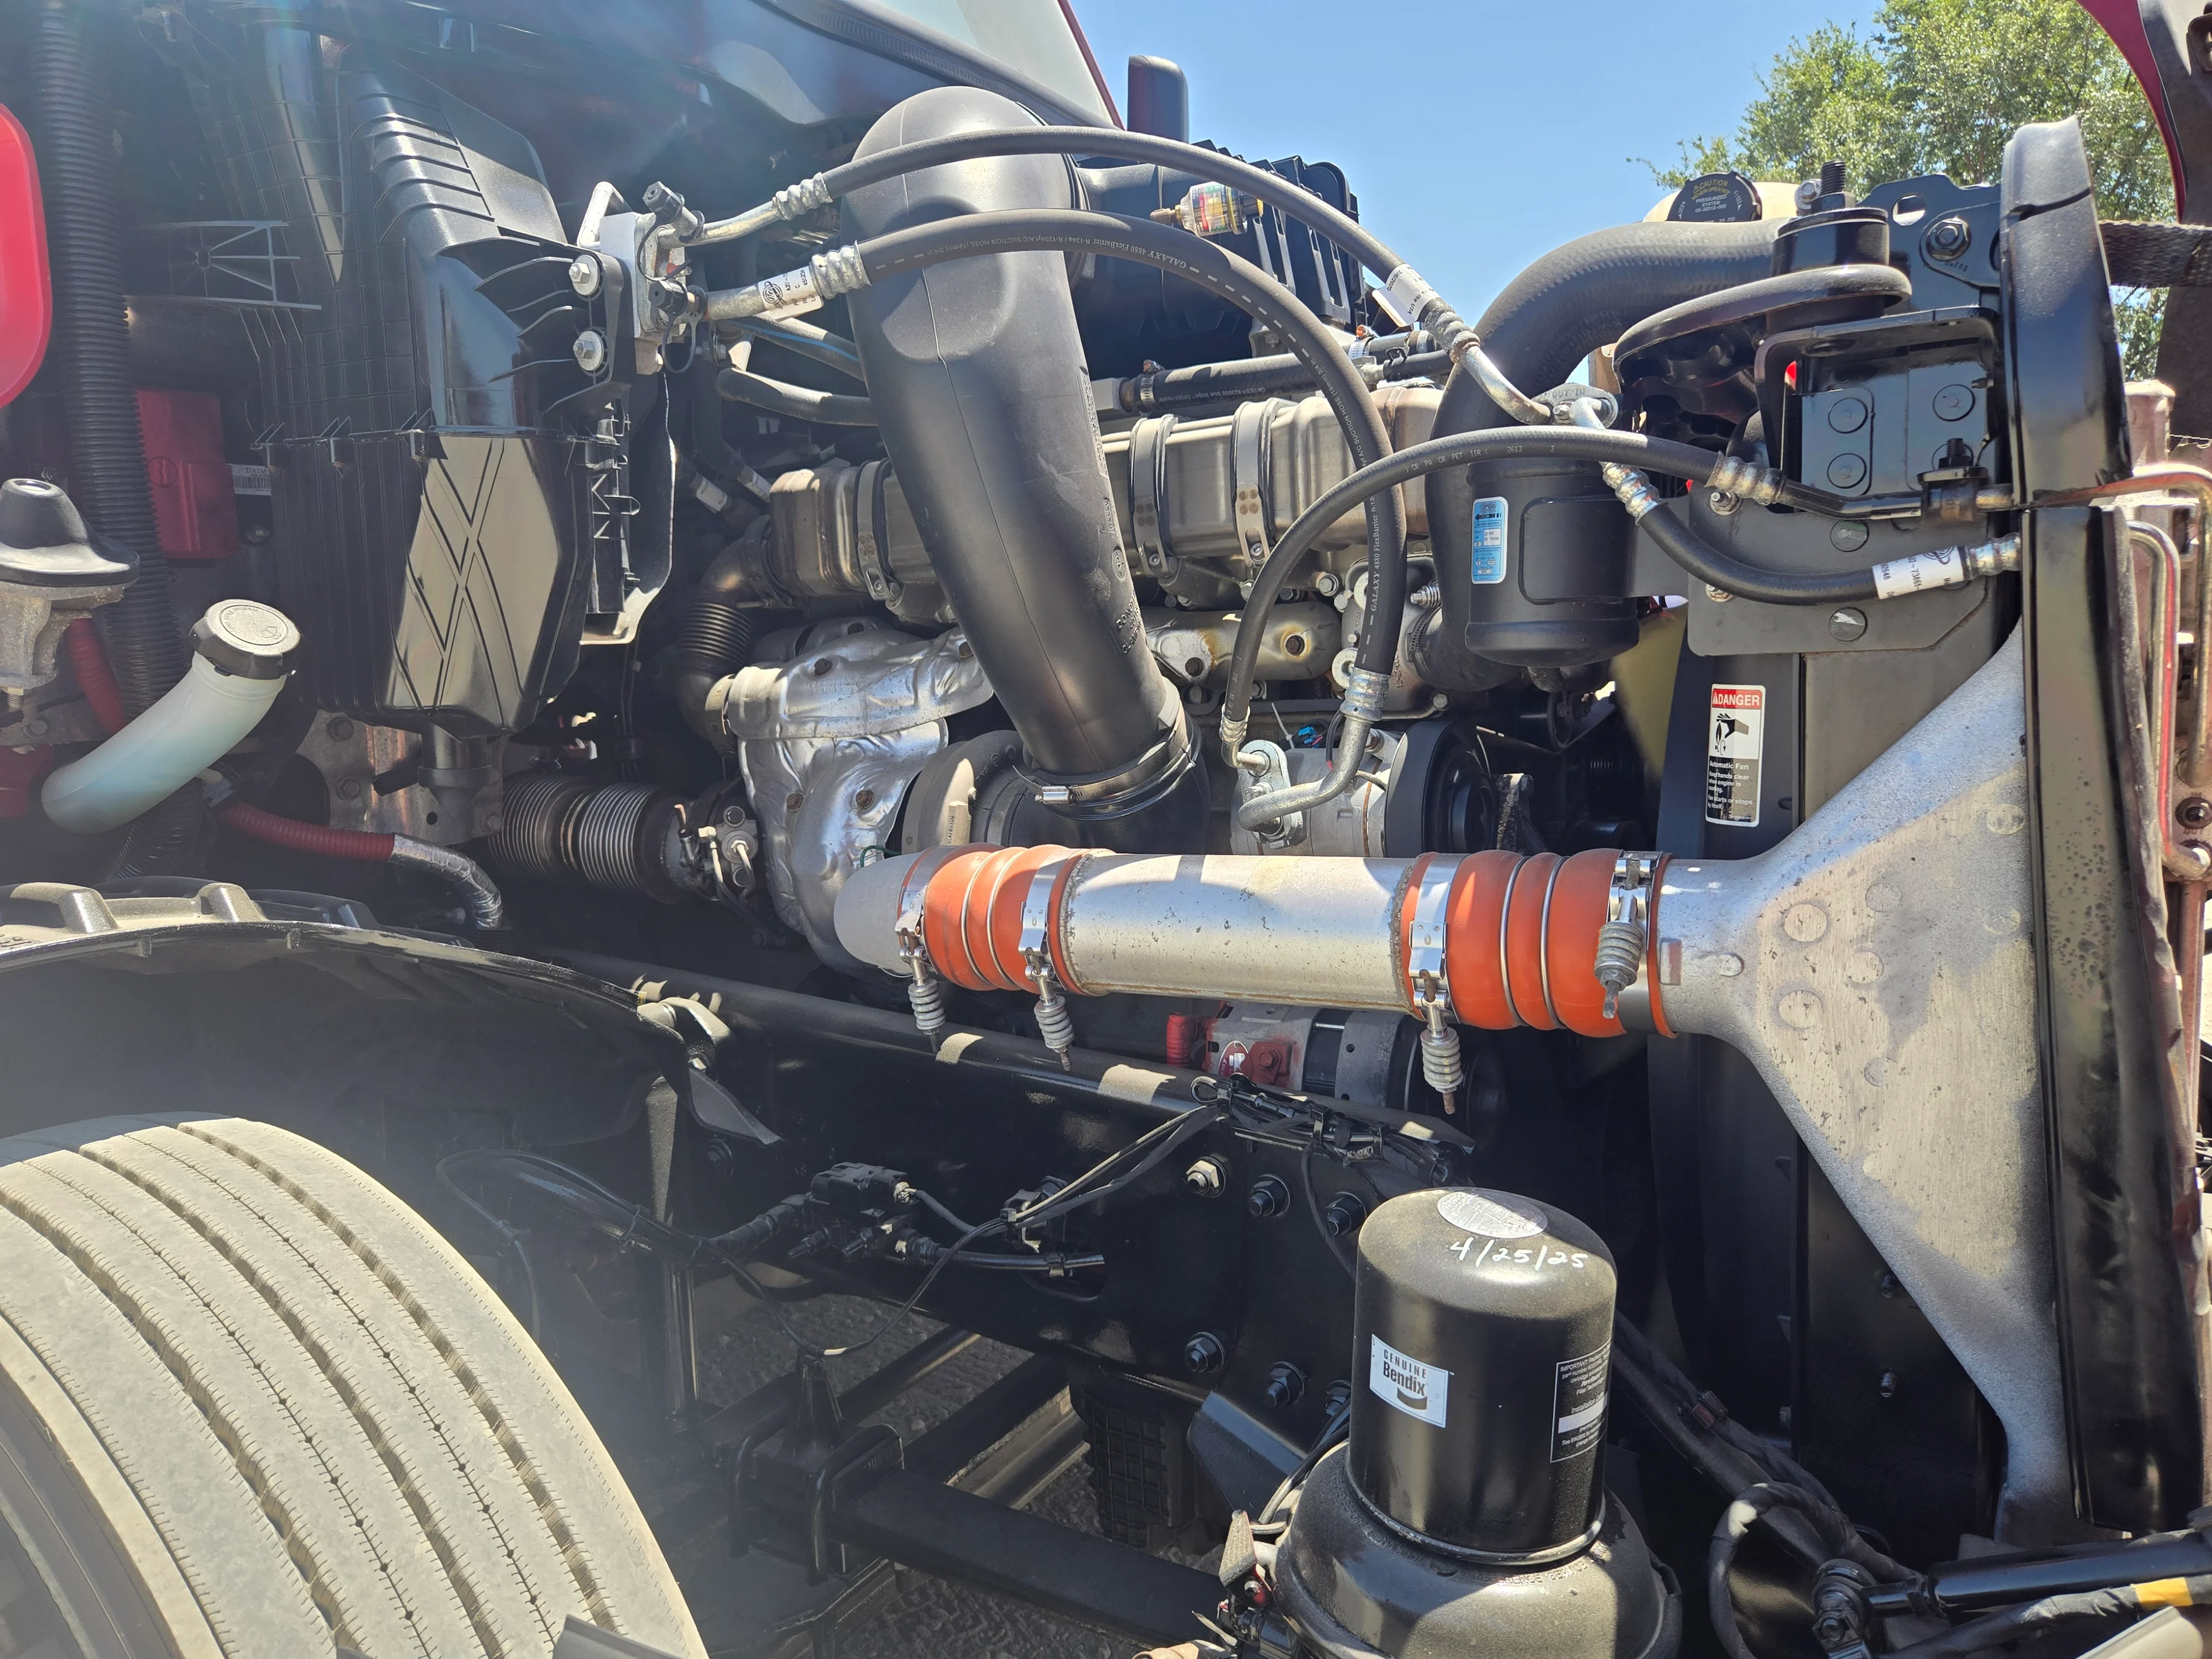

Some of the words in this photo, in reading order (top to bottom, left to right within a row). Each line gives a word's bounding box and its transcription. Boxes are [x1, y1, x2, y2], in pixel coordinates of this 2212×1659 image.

[1699, 179, 1728, 188] CAUTION
[1695, 195, 1726, 204] PRESSURIZED
[946, 242, 968, 252] (19mm)
[971, 239, 990, 248] HOSE
[991, 237, 1021, 245] SUCTION
[1093, 238, 1129, 252] FlexBarrier
[1130, 246, 1146, 255] 4880
[1147, 250, 1187, 269] GALAXY
[1311, 358, 1317, 367] in
[1314, 366, 1323, 375] 3/4
[1322, 374, 1338, 397] (19mm)
[1552, 388, 1568, 398] OUT
[1334, 397, 1347, 415] HOSE
[1344, 416, 1359, 445] SUCTION
[1371, 572, 1380, 611] GALAXY
[1718, 694, 1760, 706] DANGER
[1450, 1237, 1588, 1270] 4/25/25
[1384, 1349, 1426, 1379] GENUINE
[1384, 1360, 1425, 1396] Bendix
[1572, 1397, 1595, 1413] Installation
